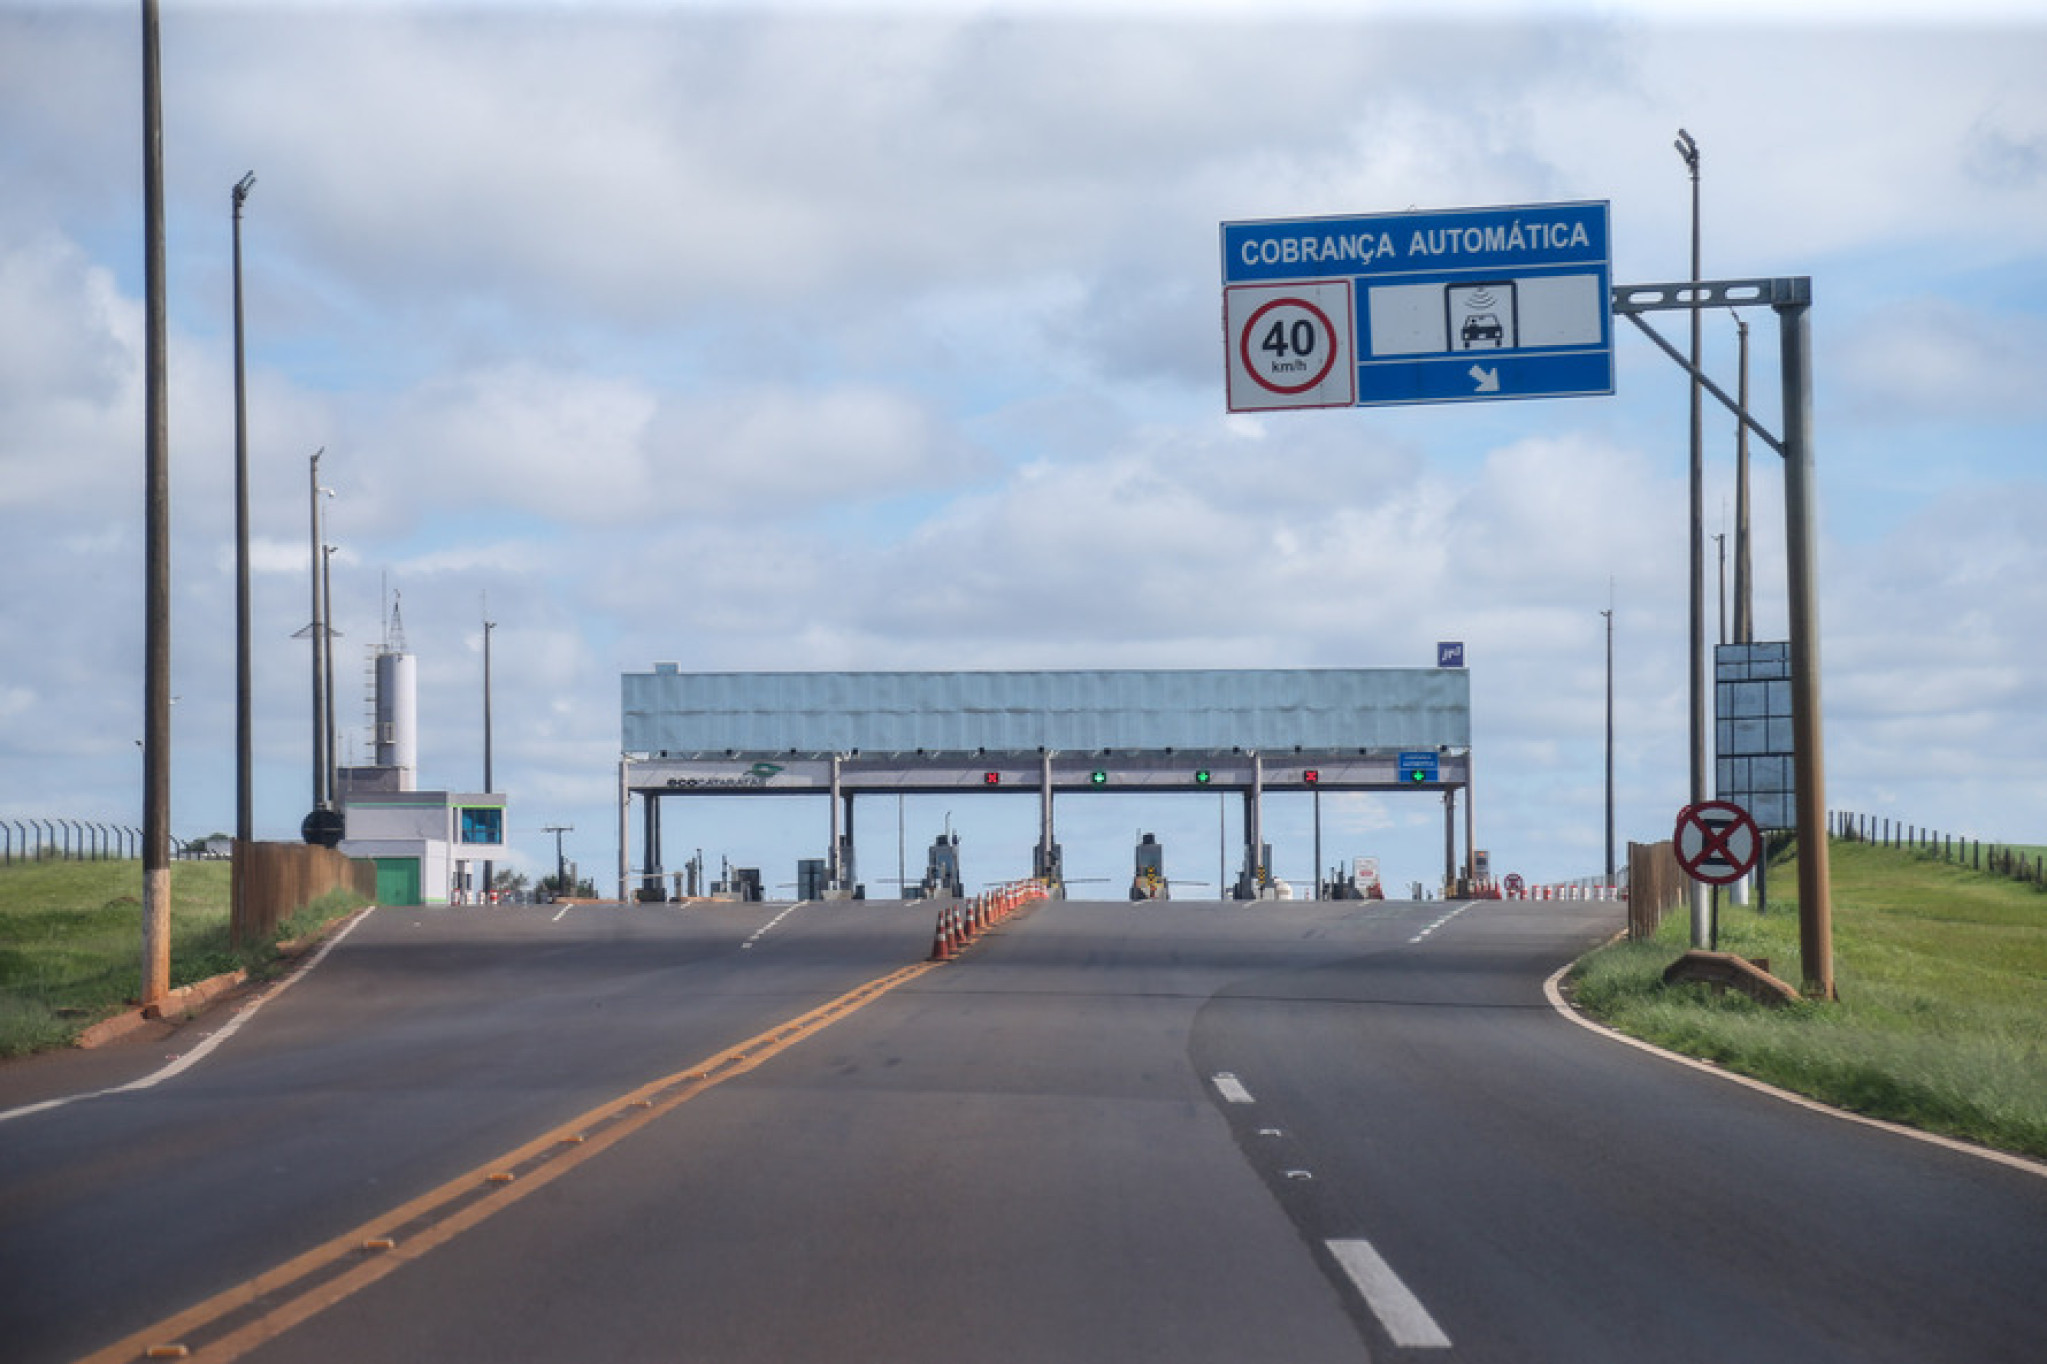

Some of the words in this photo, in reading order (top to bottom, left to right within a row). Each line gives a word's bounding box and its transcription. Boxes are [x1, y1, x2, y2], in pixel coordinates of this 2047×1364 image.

[1241, 232, 1396, 266] COBRANÇA
[1408, 219, 1590, 256] AUTOMÁTICA
[1262, 320, 1315, 357] 40
[1271, 359, 1307, 373] km/h
